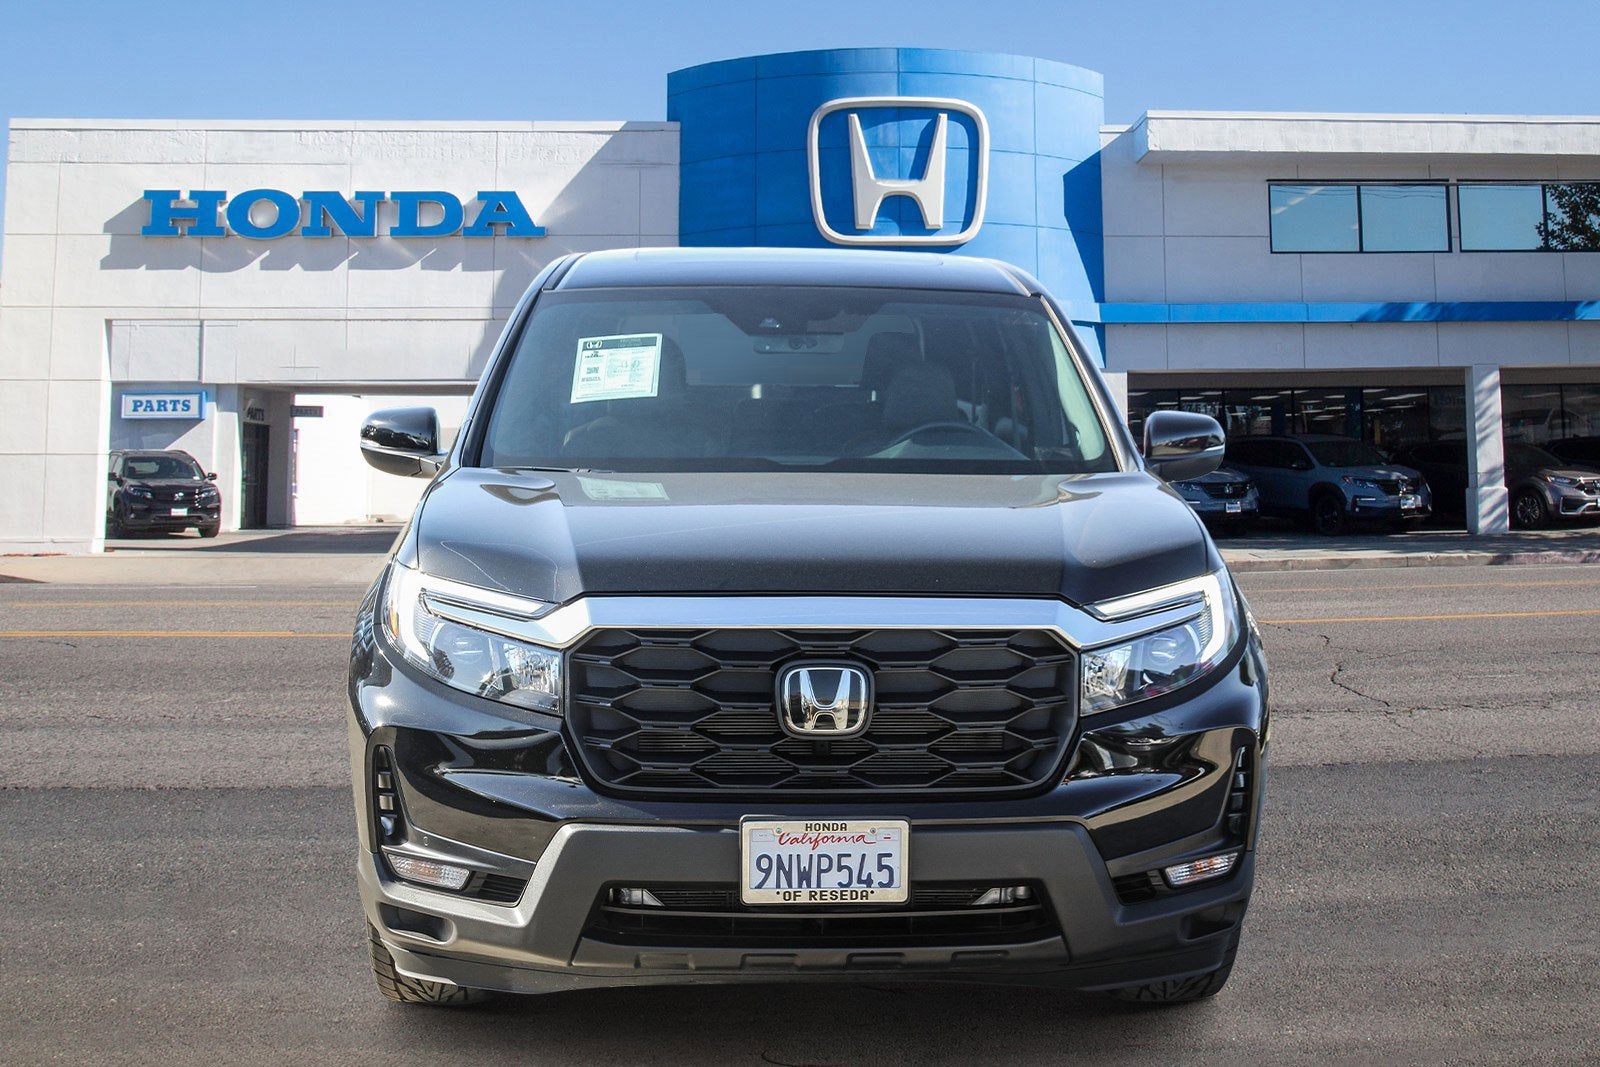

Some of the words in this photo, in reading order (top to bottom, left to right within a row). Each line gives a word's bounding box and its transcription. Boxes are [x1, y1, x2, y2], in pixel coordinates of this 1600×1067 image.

[141, 188, 547, 239] HONDA
[131, 399, 192, 412] PARTS
[805, 822, 848, 832] HONDA
[778, 832, 877, 850] California
[754, 852, 895, 889] 9NWP545
[783, 890, 802, 901] OF
[808, 890, 869, 901] RESEDA
